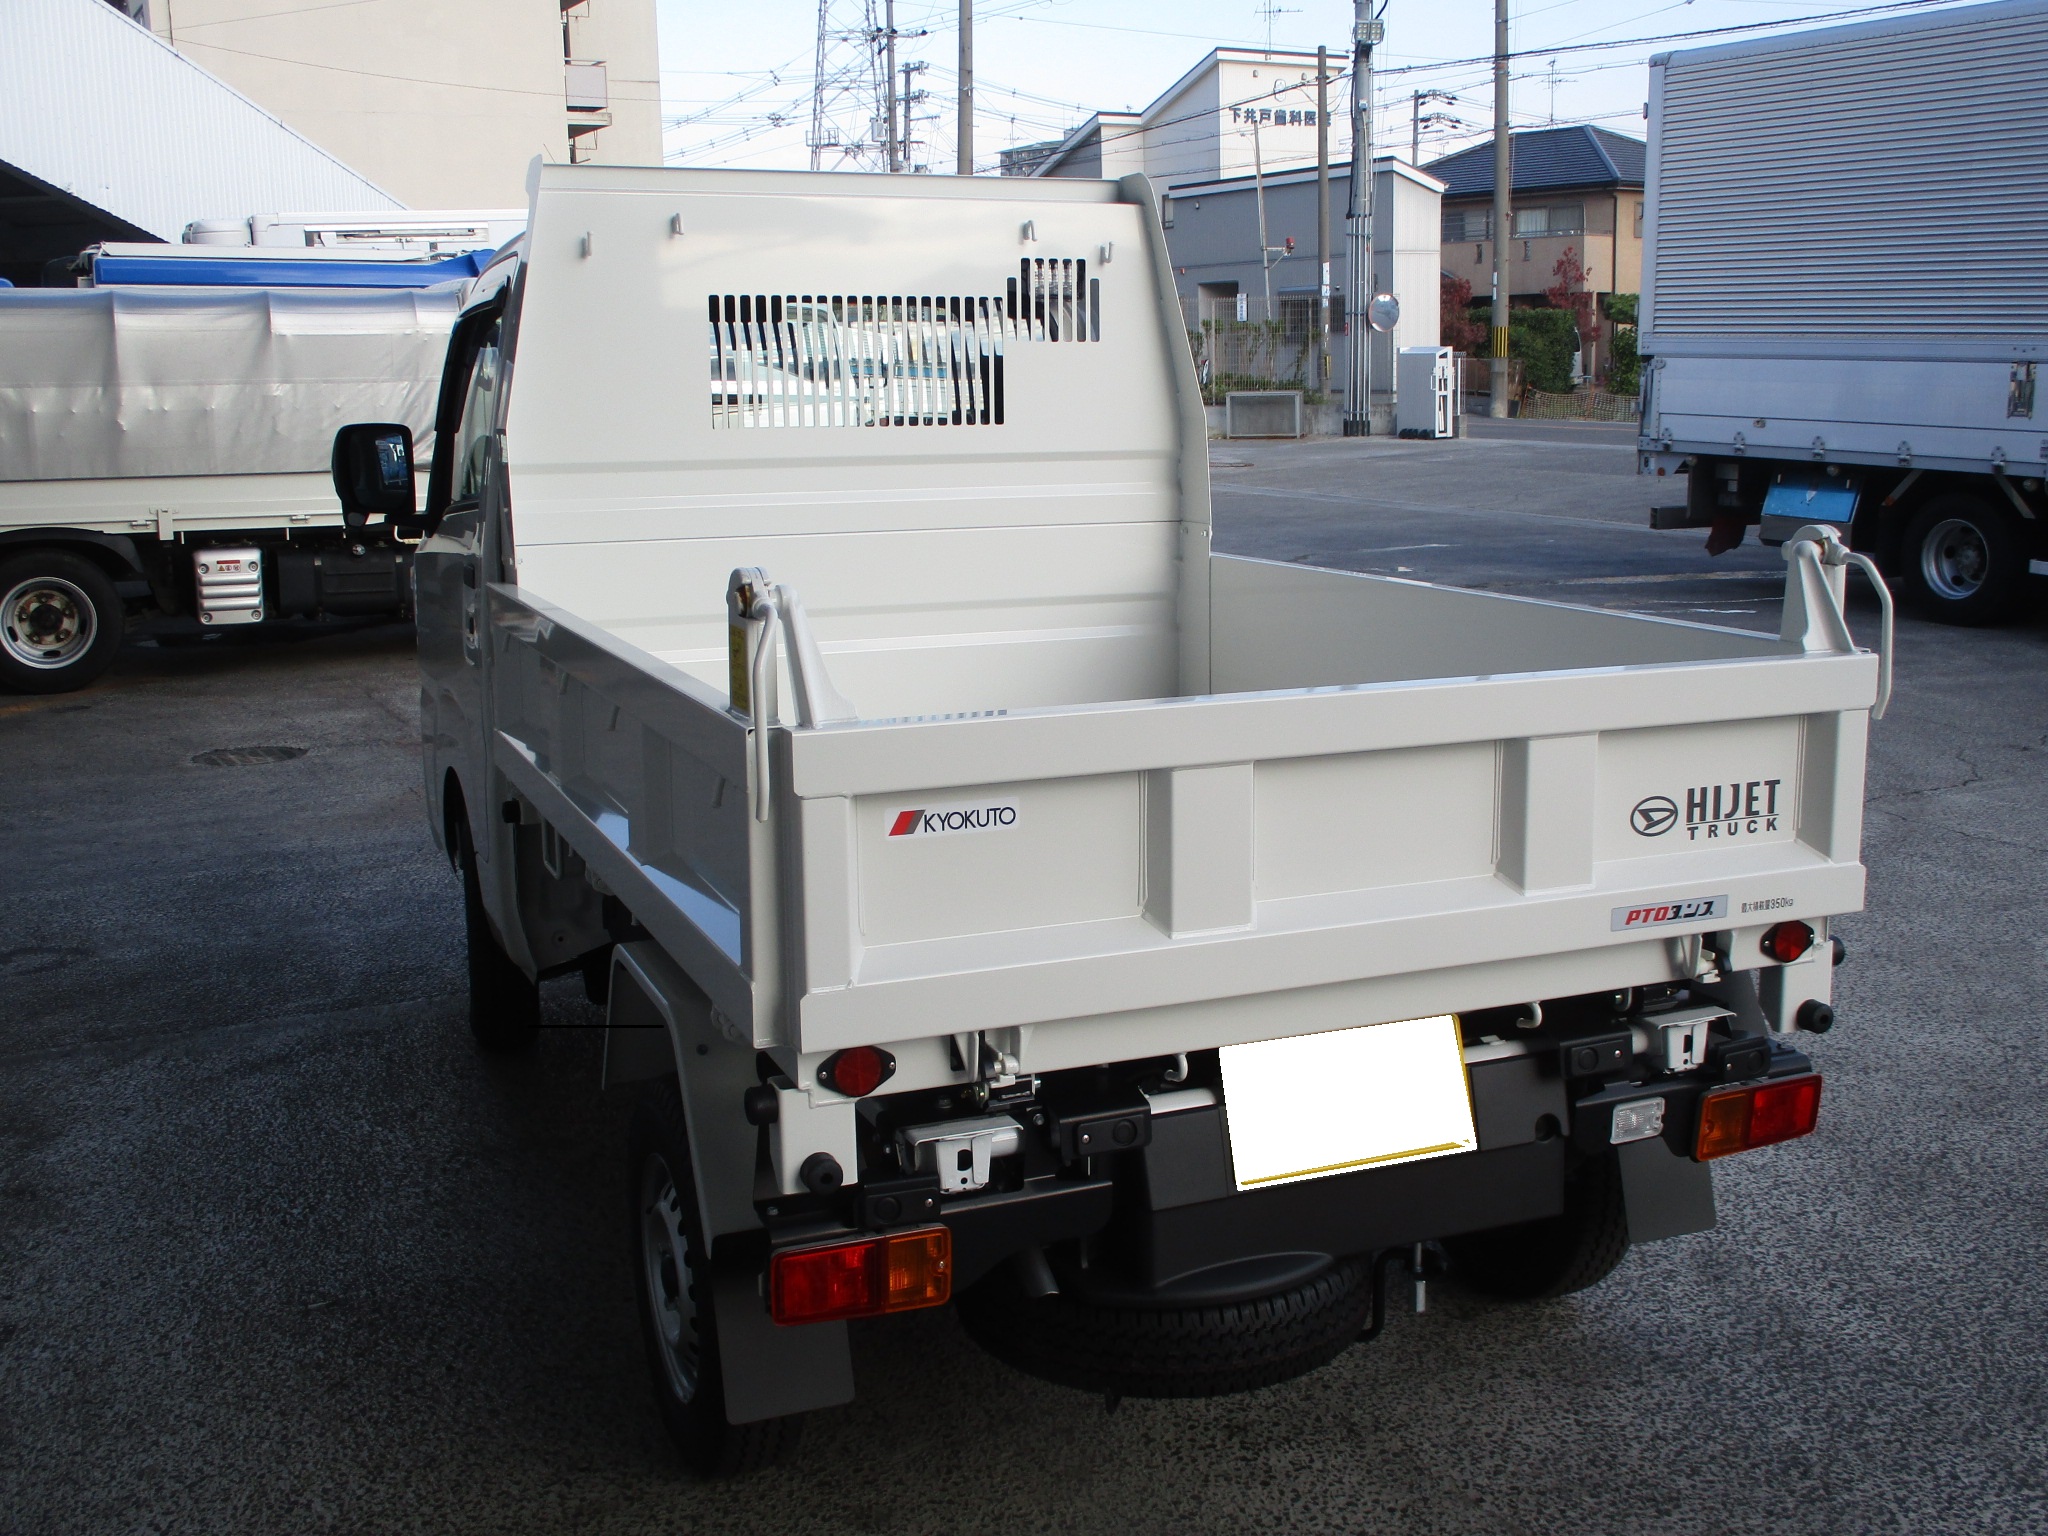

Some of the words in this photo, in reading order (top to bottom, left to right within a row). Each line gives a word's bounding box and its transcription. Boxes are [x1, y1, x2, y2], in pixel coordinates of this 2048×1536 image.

[1686, 779, 1781, 823] HIJET
[924, 806, 1016, 833] KYOKUTO
[1687, 817, 1777, 840] TRUCK
